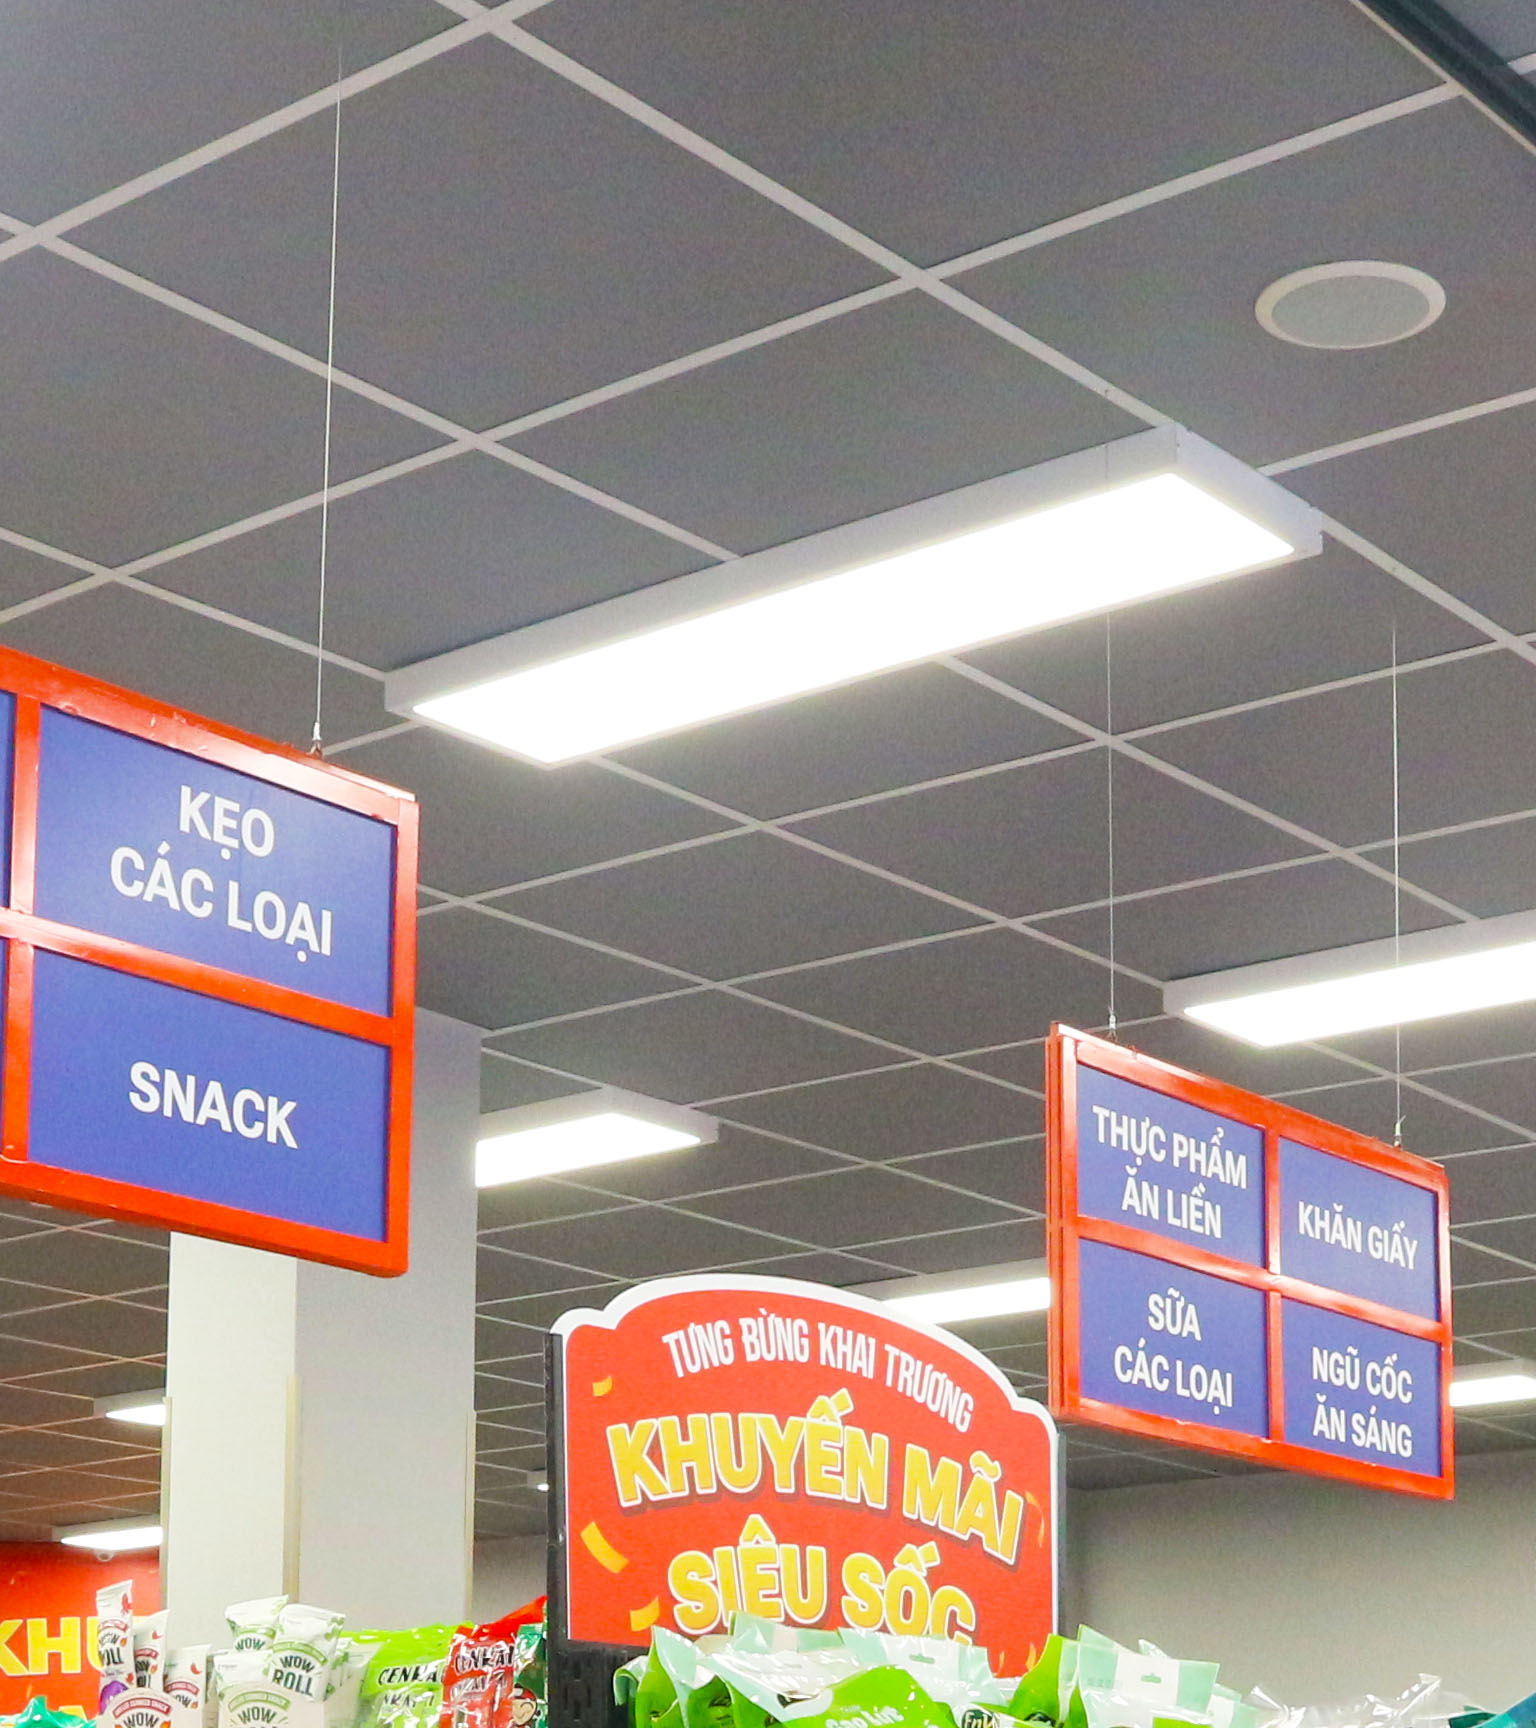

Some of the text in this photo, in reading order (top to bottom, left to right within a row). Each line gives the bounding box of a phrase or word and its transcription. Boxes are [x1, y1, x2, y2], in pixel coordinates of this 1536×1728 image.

[179, 784, 275, 858] KẸO
[109, 833, 333, 964] CÁC LOẠI
[128, 1061, 298, 1148] SNACK
[1092, 1105, 1247, 1189] THỰC PHẨM
[1121, 1165, 1221, 1238] ĂN LIỀN
[1298, 1201, 1418, 1270] KHĂN GIẤY
[1148, 1287, 1200, 1340] SỮA
[663, 1308, 973, 1433] TƯNG BỪNG KHAI TRƯƠNG
[1114, 1337, 1232, 1414] CÁC LOẠI
[1311, 1346, 1412, 1403] NGŨ CỐC
[1313, 1393, 1412, 1458] ĂN SÁNG
[606, 1388, 1024, 1565] KHUYẾN MÃI
[667, 1514, 976, 1645] SIÊU SỐC
[238, 1708, 277, 1724] WOW
